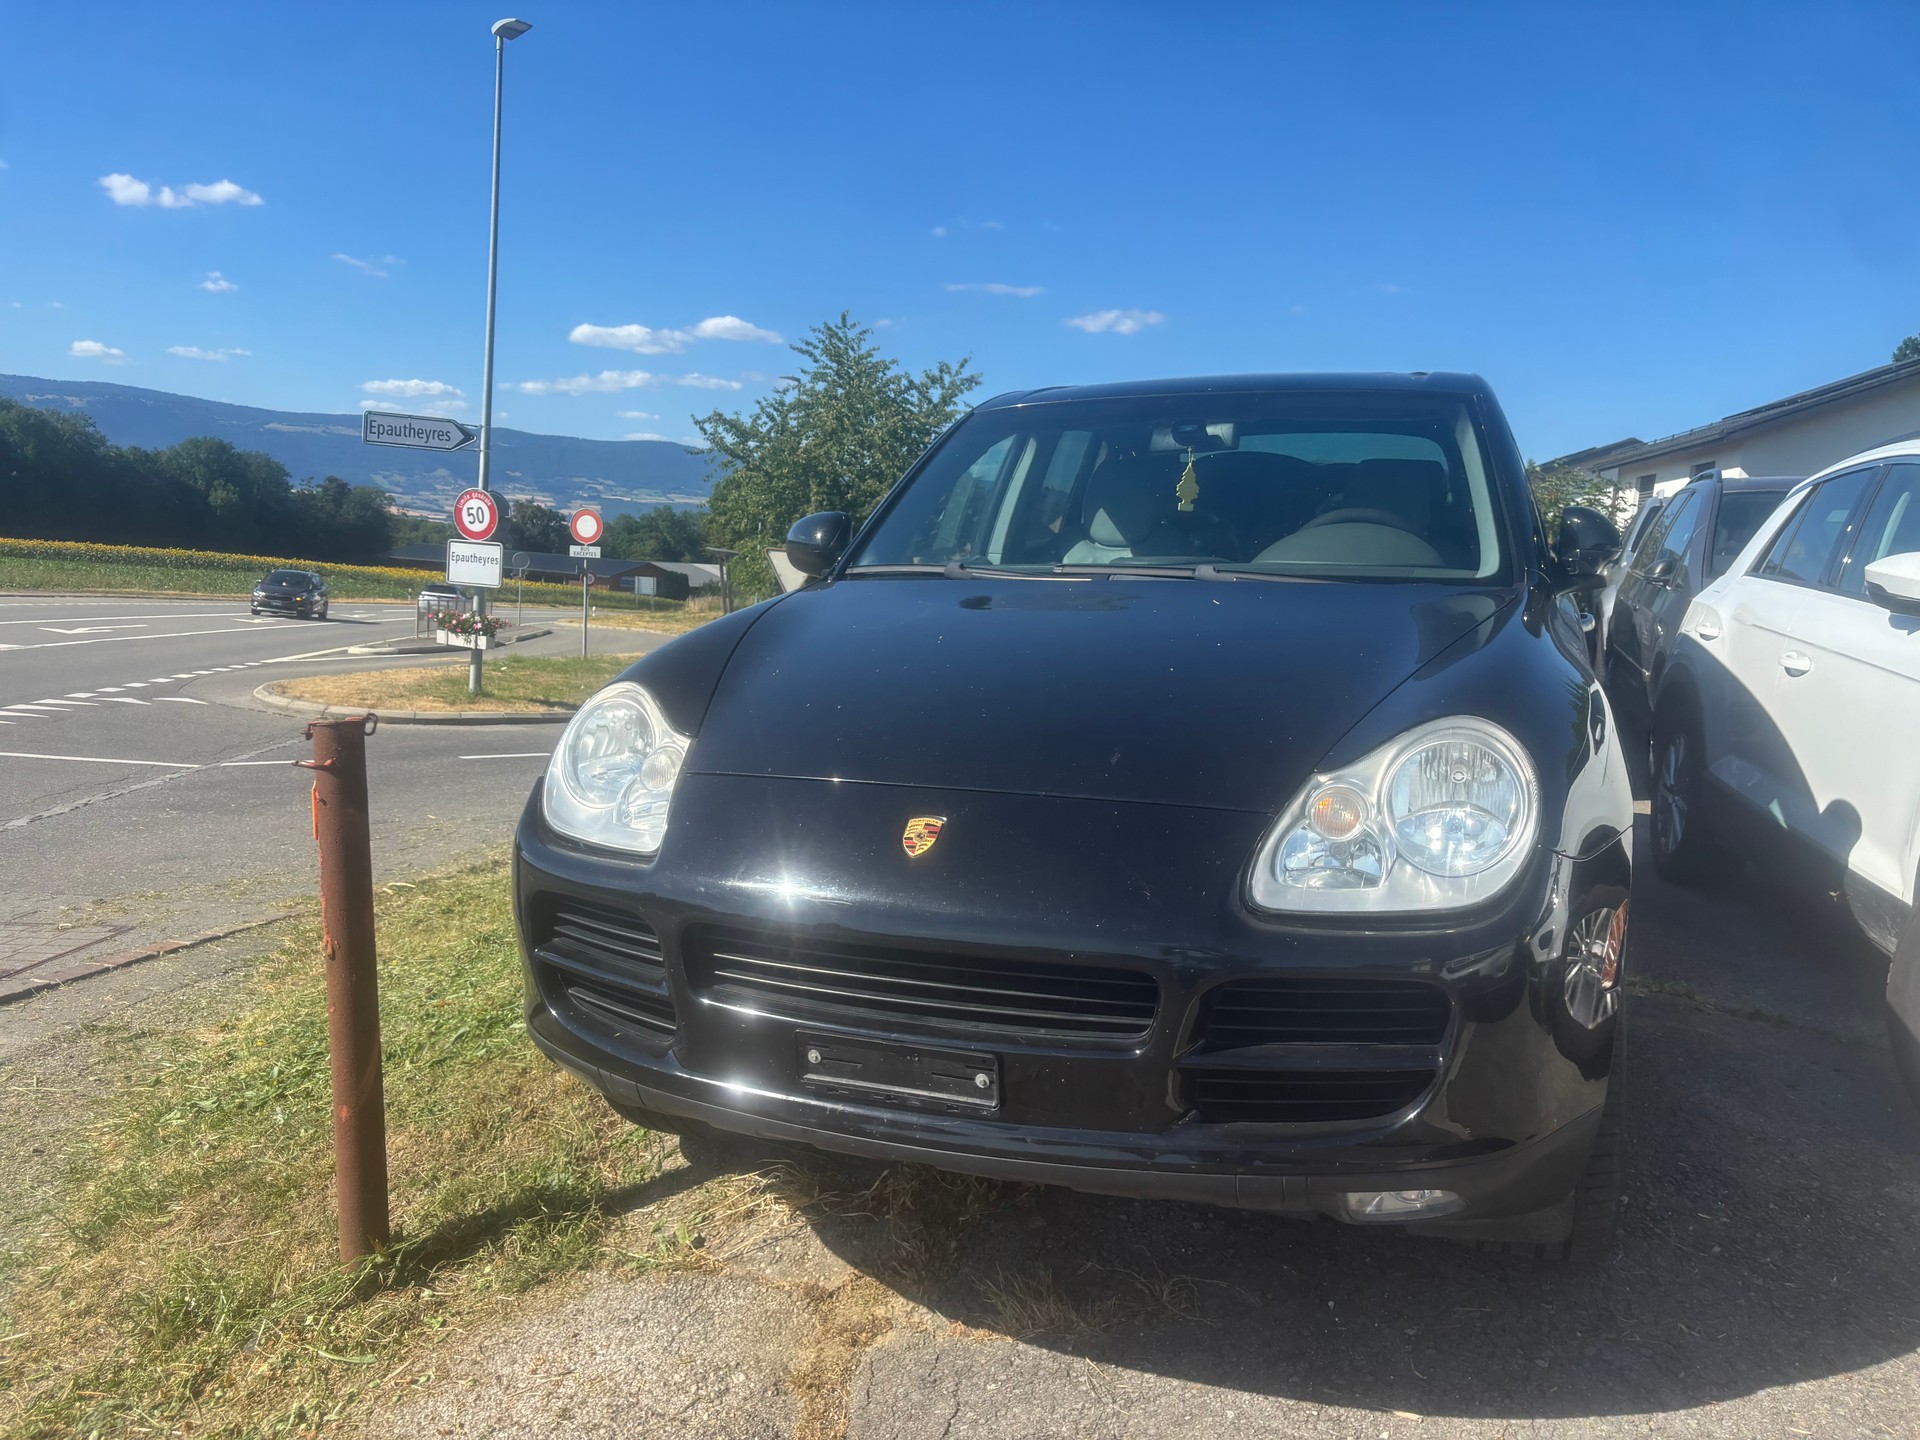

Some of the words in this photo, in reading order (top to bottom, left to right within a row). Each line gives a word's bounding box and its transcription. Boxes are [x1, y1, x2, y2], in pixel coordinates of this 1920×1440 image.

[369, 420, 451, 443] Epautheyres
[466, 506, 485, 525] 50
[451, 551, 499, 567] Epautheyres
